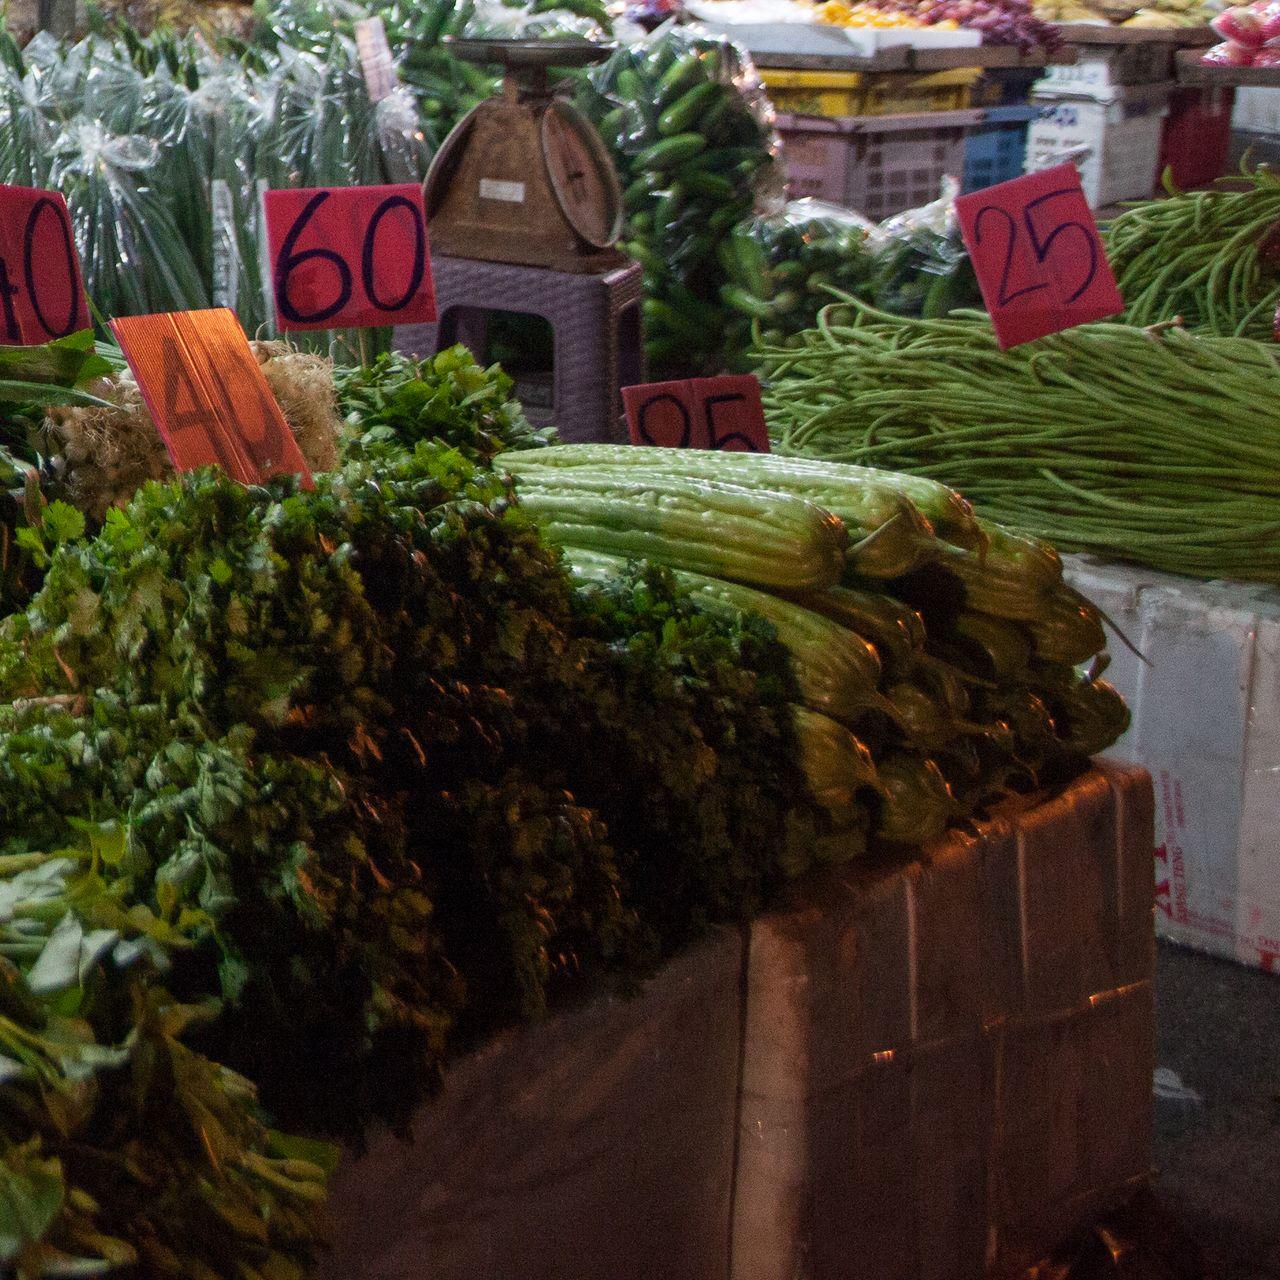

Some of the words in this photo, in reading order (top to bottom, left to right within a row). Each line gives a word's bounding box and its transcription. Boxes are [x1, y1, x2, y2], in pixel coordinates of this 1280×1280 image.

[275, 191, 427, 322] 60
[975, 189, 1098, 306] 25
[161, 334, 284, 476] 40
